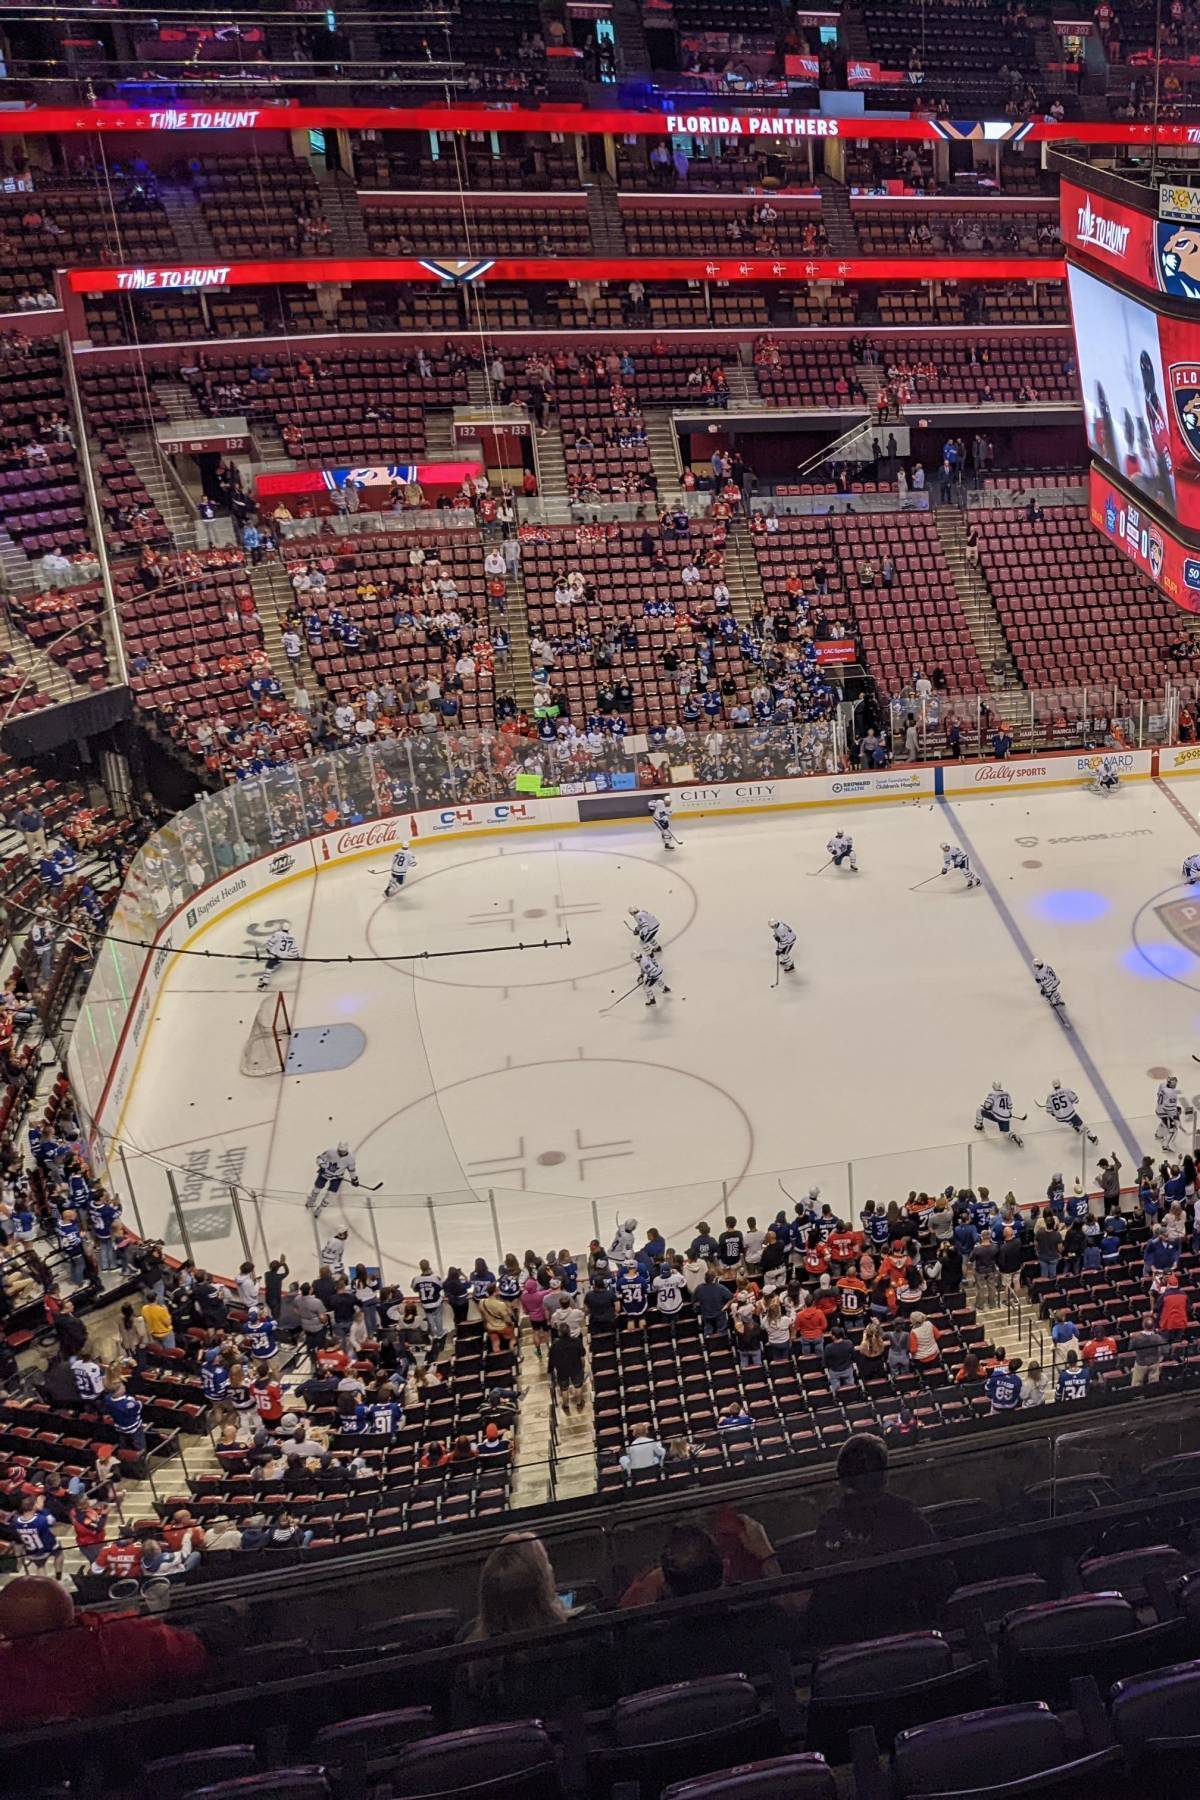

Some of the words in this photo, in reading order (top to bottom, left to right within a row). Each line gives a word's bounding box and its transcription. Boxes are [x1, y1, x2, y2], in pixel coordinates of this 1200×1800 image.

[150, 110, 195, 129] TIME
[191, 113, 212, 128] TO
[216, 111, 260, 128] HUNT
[667, 116, 742, 133] FLORIDA
[750, 117, 839, 136] PANTHERS
[1095, 216, 1108, 240] TO
[1107, 220, 1131, 253] HUNT
[117, 269, 160, 288] TIME
[161, 271, 183, 287] TO
[183, 269, 231, 286] HUNT
[459, 426, 476, 437] 132
[511, 425, 527, 436] 133
[168, 443, 183, 454] 131
[226, 438, 244, 450] 132
[1119, 510, 1125, 538] 0
[1141, 530, 1148, 558] 0
[1188, 568, 1200, 579] 50
[975, 766, 1016, 782] Bally
[1016, 767, 1046, 778] SPORTS
[680, 790, 721, 801] CITY
[736, 786, 775, 797] CITY
[337, 820, 400, 854] Coca-Cola
[393, 854, 405, 867] 78
[220, 879, 248, 901] Health
[279, 940, 293, 952] 37
[1052, 1095, 1067, 1111] 65
[726, 1242, 740, 1257] 16
[419, 1287, 434, 1300] 17
[622, 1288, 642, 1303] 34
[659, 1287, 676, 1302] 34
[840, 1295, 858, 1309] 10
[227, 1389, 246, 1400] 27
[1065, 1386, 1087, 1400] 34
[256, 1395, 272, 1411] 16
[375, 1415, 392, 1434] 91
[20, 1533, 44, 1551] 91
